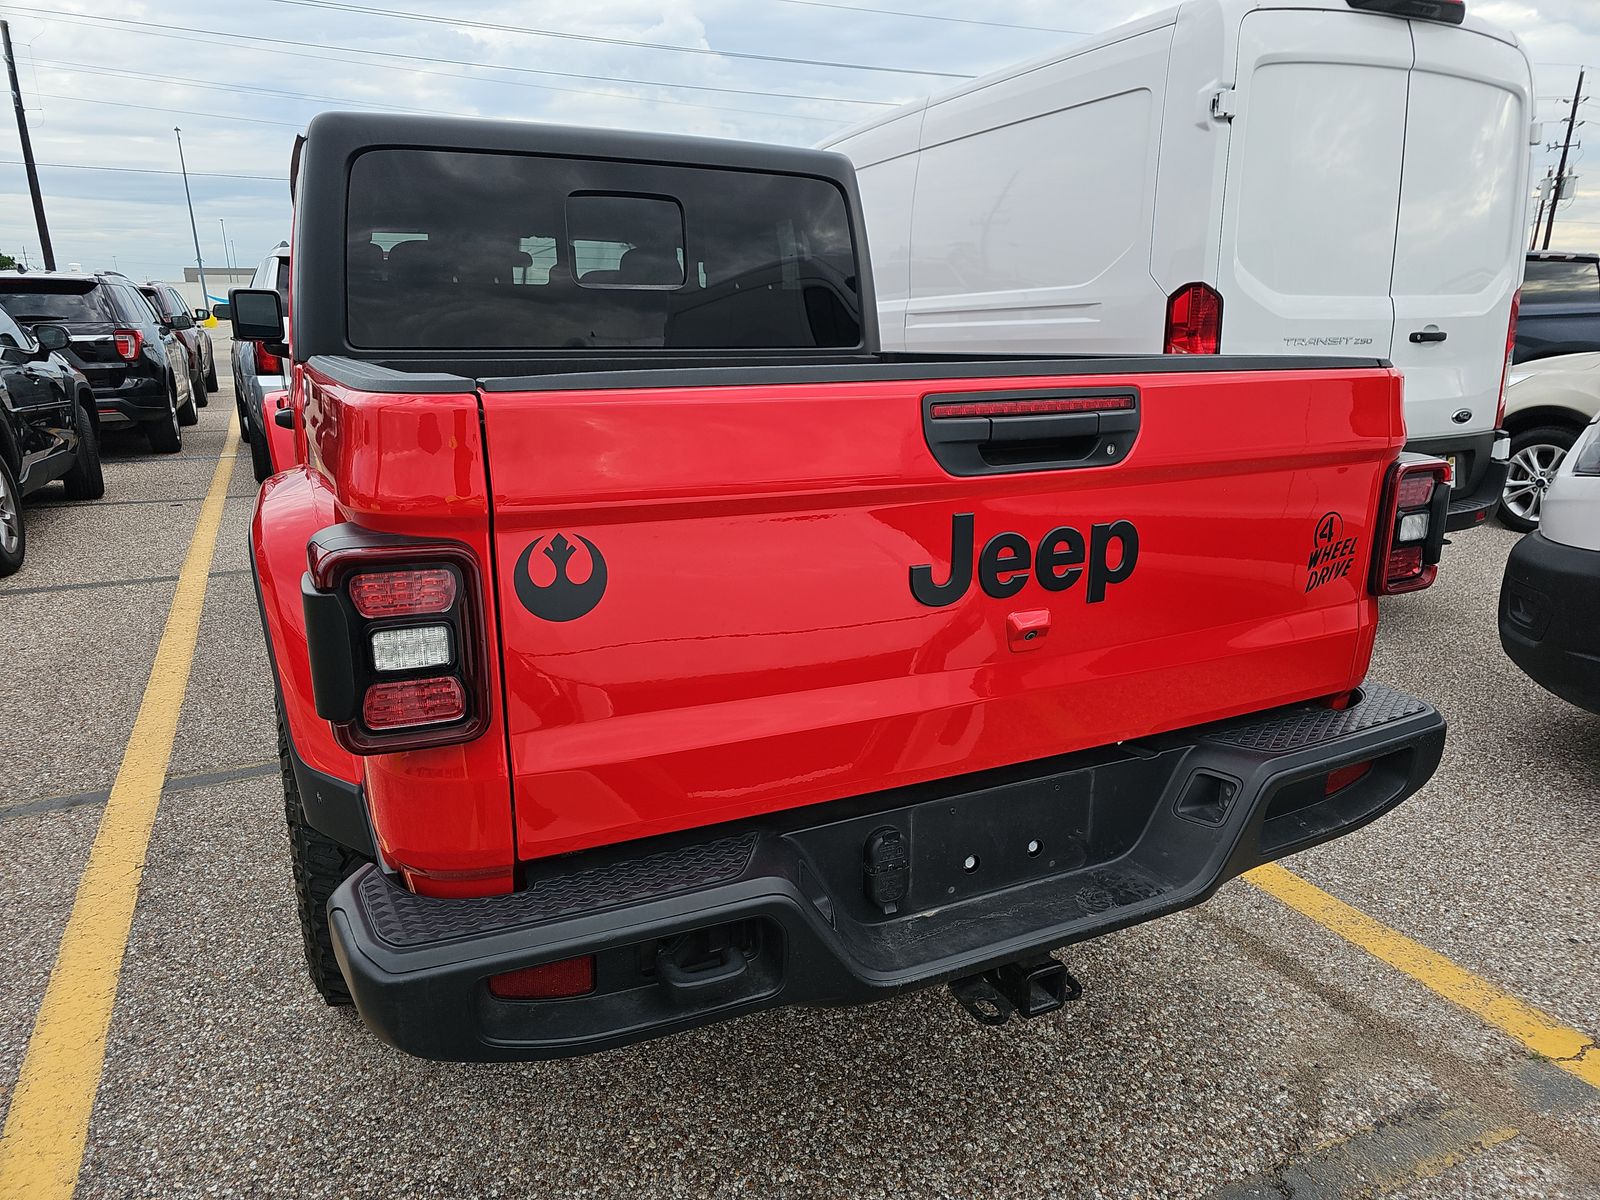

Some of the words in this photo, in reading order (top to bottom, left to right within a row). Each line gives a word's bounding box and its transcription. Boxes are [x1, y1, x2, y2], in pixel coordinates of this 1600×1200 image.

[1283, 336, 1353, 346] TRANSIT
[1319, 516, 1335, 542] 4
[909, 512, 1139, 607] Jeep
[1307, 536, 1358, 571] WHEEL
[1304, 558, 1355, 593] DRIVE
